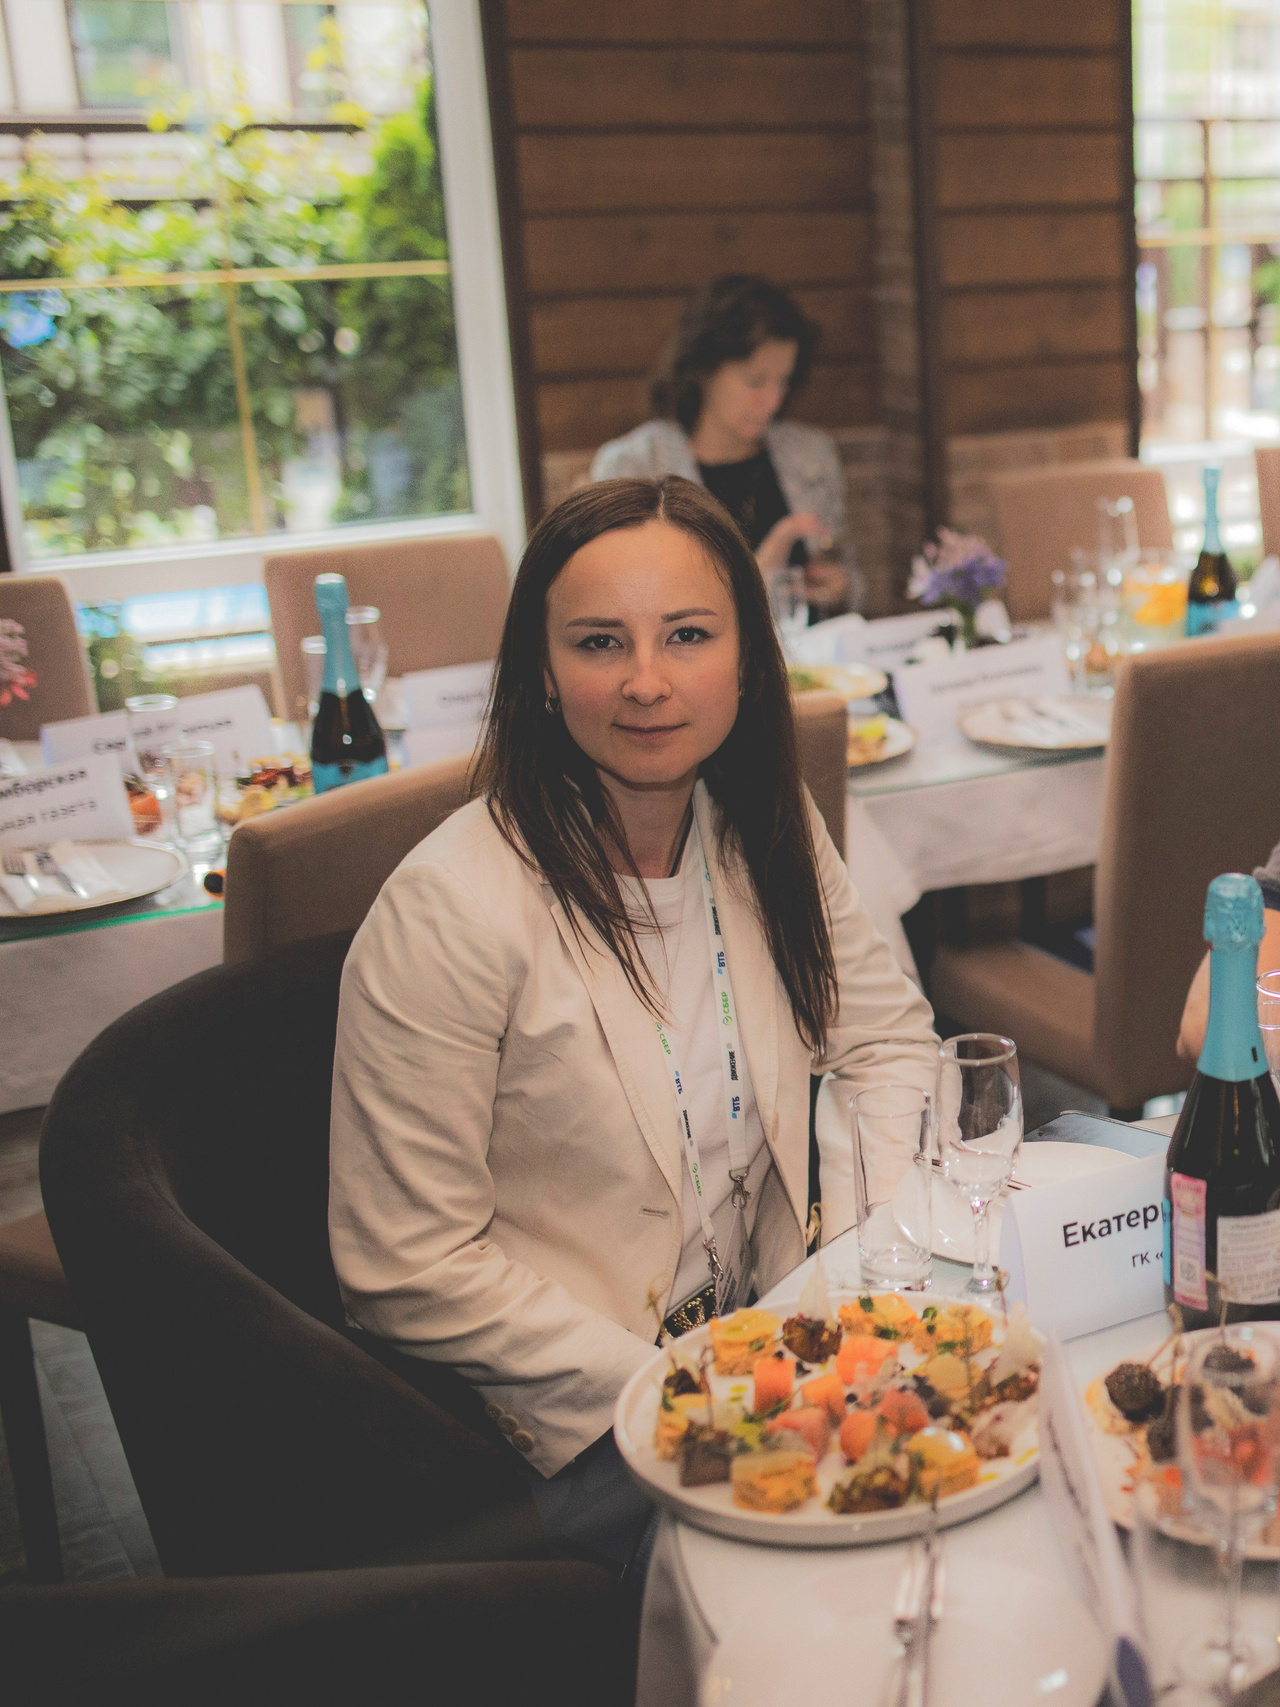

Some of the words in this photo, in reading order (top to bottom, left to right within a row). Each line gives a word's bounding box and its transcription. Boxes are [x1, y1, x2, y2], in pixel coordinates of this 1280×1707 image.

[717, 951, 725, 968] ВТБ
[659, 1033, 671, 1055] СБЕР
[674, 1078, 683, 1095] ВТБ
[732, 1096, 740, 1112] ВТБ
[694, 1174, 702, 1196] СБЕР
[1132, 1251, 1150, 1267] ГК
